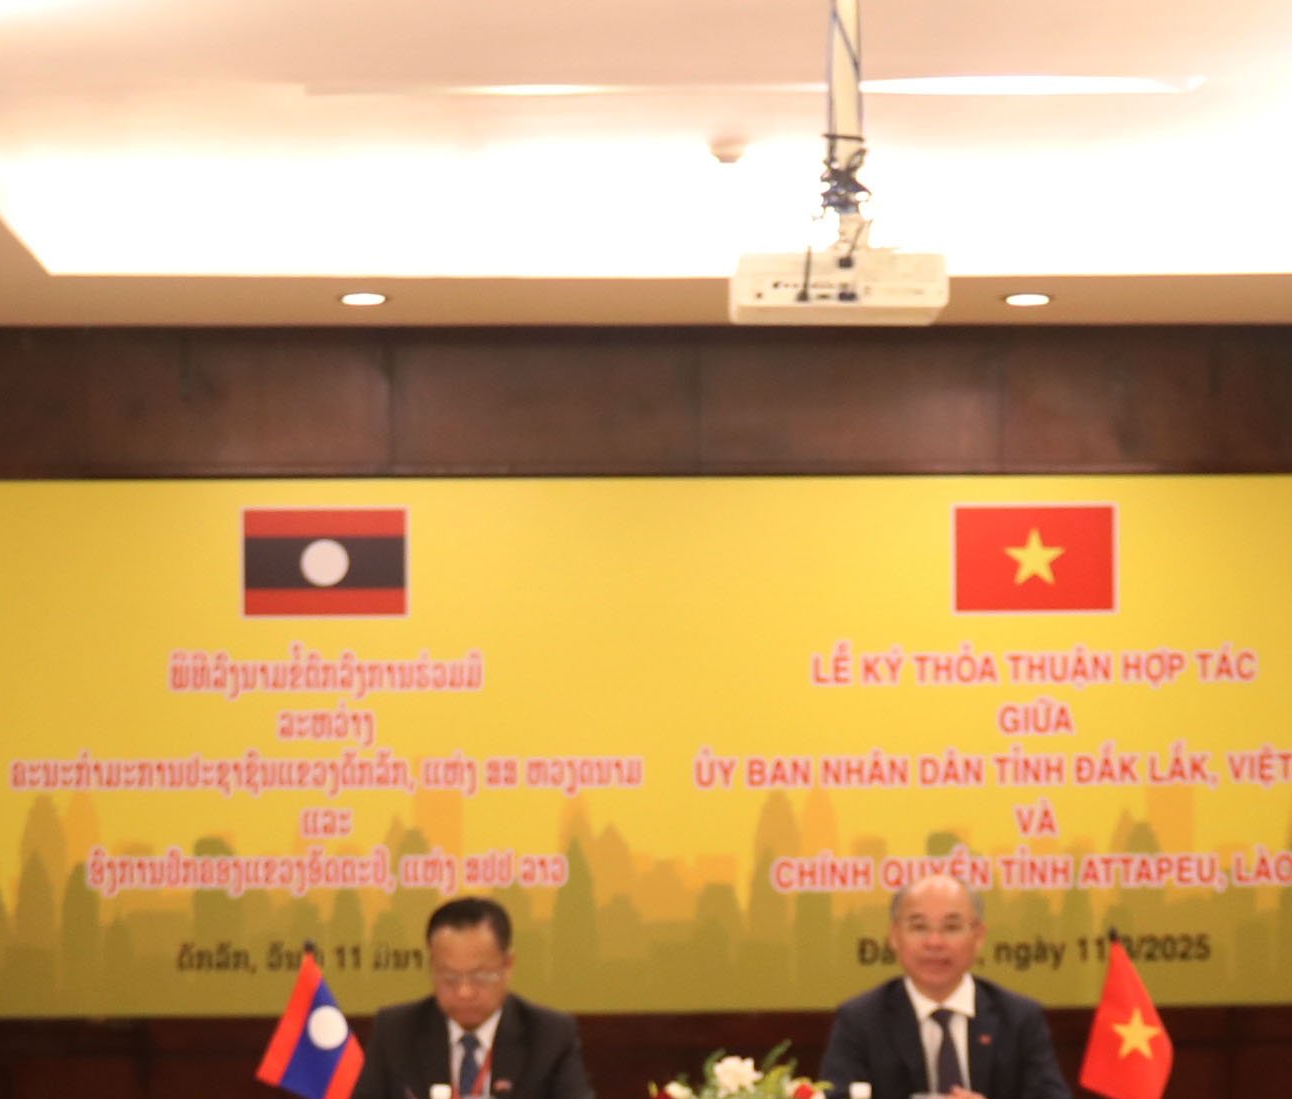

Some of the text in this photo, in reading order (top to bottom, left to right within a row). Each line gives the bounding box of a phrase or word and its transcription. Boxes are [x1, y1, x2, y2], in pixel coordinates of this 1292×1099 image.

[861, 647, 903, 684] KÝ
[914, 645, 997, 683] THỎA
[1007, 647, 1109, 688] THUẬN
[1121, 651, 1185, 687] HỢP
[1197, 644, 1256, 681] TÁC
[997, 698, 1075, 734] GIỮA
[694, 747, 736, 788] ỦY
[746, 758, 811, 787] BAN
[822, 749, 909, 786] NHÂN
[919, 748, 984, 785] DÂN
[994, 745, 1064, 785] TỈNH
[1014, 799, 1057, 835] VÀ
[774, 850, 873, 889] CHÍNH
[1002, 846, 1072, 887] TỈNH
[1080, 853, 1226, 890] ATTAPEU,
[335, 944, 361, 971] 11
[993, 935, 1066, 970] ngày
